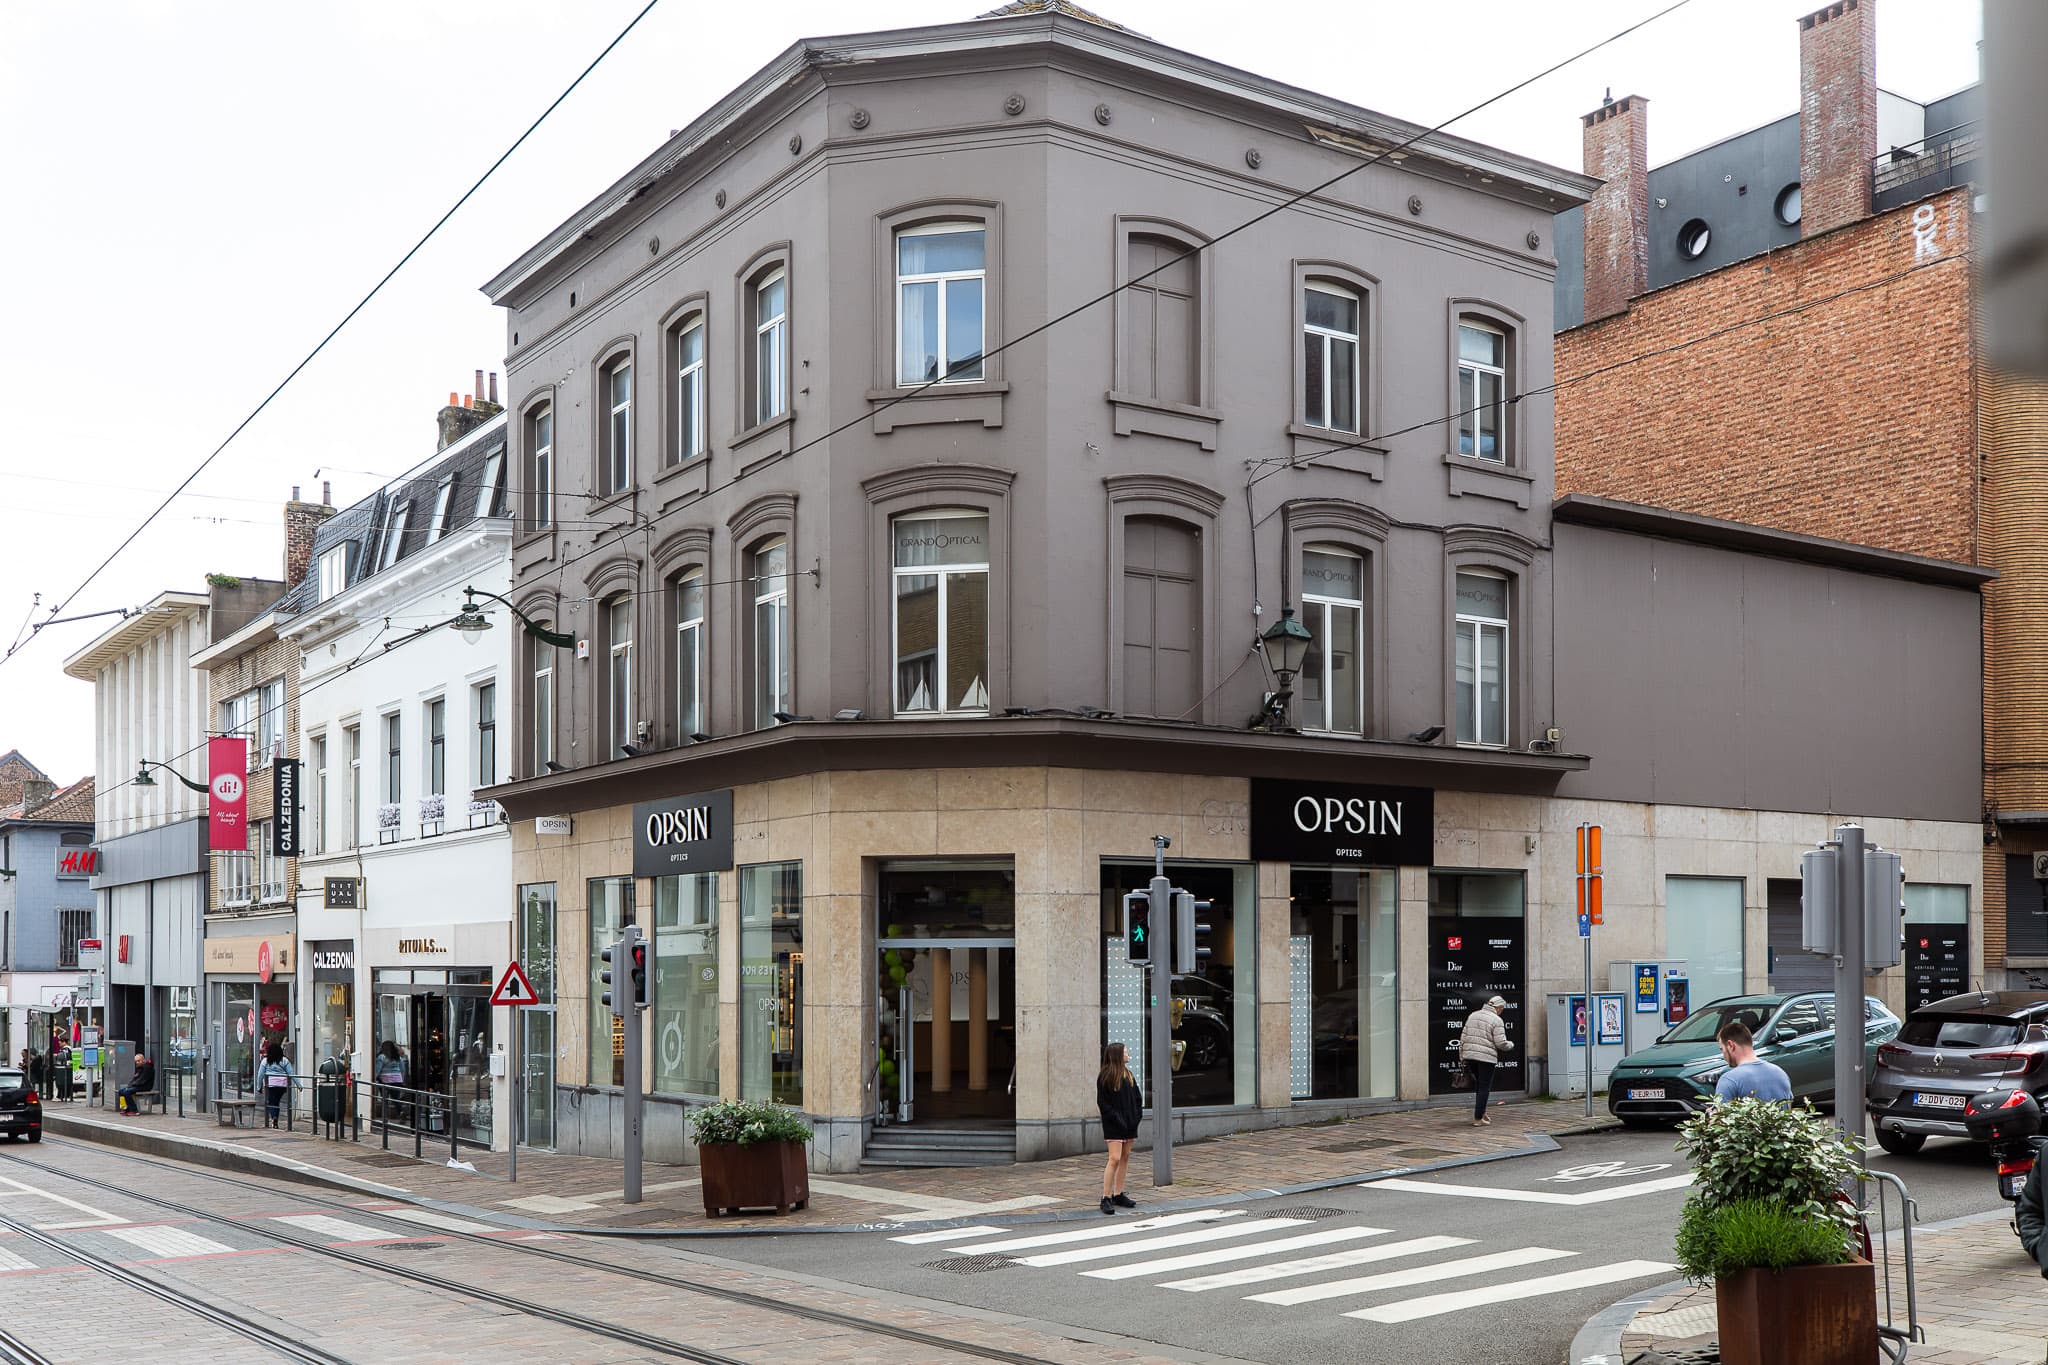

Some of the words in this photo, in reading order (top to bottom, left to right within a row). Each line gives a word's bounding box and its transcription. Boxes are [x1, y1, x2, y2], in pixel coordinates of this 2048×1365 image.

[219, 781, 237, 794] di!
[281, 764, 292, 851] CALZEDONIA
[1293, 796, 1402, 836] OPSIN
[541, 819, 568, 829] OPSIN
[646, 806, 709, 847] OPSIN
[670, 853, 689, 862] OPTICS
[1335, 848, 1363, 857] OPTICS
[60, 851, 97, 874] H&M
[313, 951, 354, 969] CALZEDONI
[1492, 961, 1509, 969] BOSS
[1447, 961, 1463, 972] Dior
[1447, 998, 1463, 1006] POLO
[1447, 1021, 1463, 1029] FENDI
